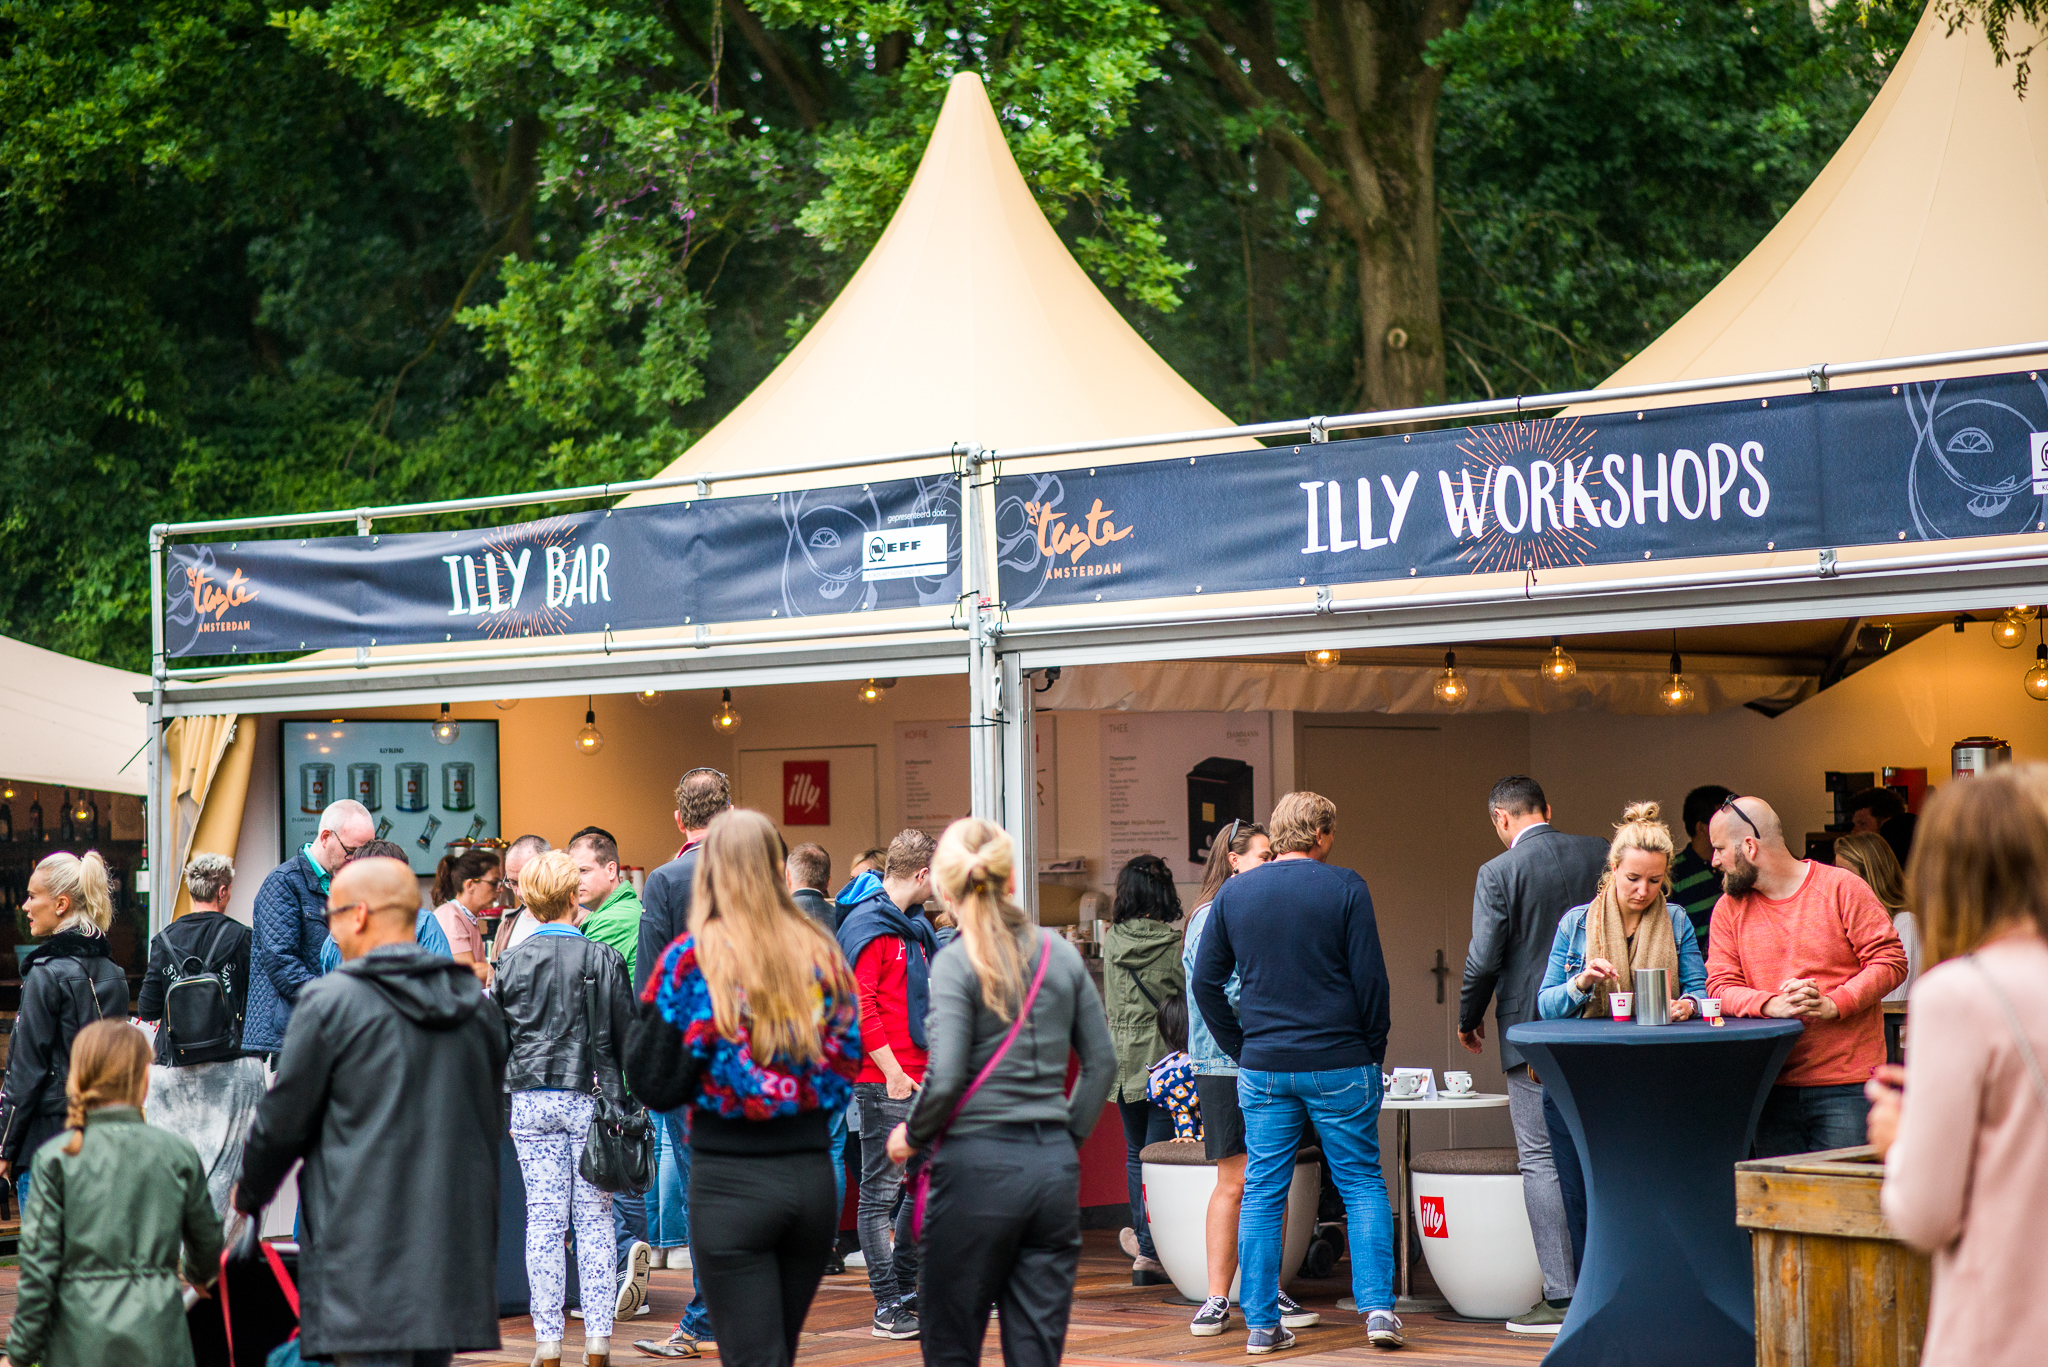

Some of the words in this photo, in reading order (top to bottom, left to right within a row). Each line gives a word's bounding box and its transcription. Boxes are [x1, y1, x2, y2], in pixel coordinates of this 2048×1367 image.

[1300, 470, 1419, 554] ILLY
[1439, 441, 1770, 539] WORKSHOPS
[887, 509, 931, 524] gepresenteerd
[931, 508, 947, 518] door
[1034, 498, 1133, 564] taste
[870, 538, 921, 558] NEFF
[441, 547, 532, 617] ILLY
[545, 542, 612, 608] BAR
[1045, 562, 1122, 580] AMSTERDAM
[191, 567, 260, 620] taste
[197, 620, 252, 634] AMSTERDAM
[1109, 723, 1129, 733] THEE
[787, 772, 821, 815] illy
[1422, 1202, 1444, 1235] illy
